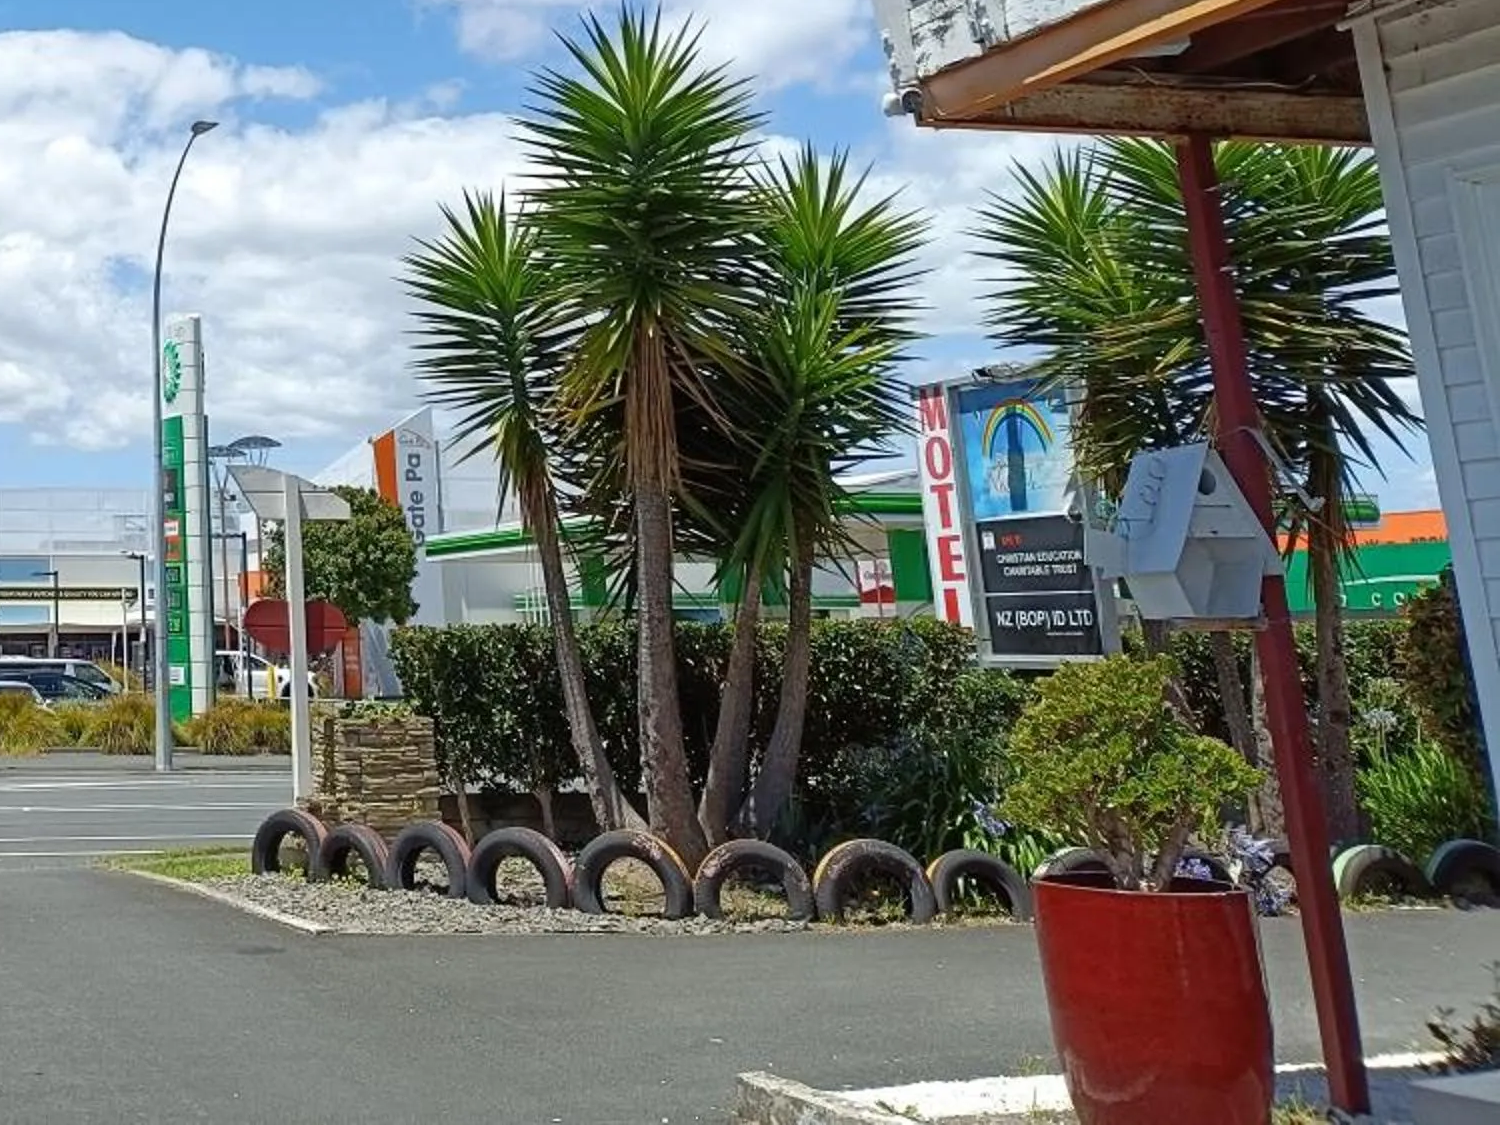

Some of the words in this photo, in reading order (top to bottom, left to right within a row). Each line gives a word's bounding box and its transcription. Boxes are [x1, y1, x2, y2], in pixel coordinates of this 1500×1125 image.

[405, 453, 422, 482] Pa
[1051, 564, 1077, 575] TRUST
[995, 610, 1013, 627] NZ
[1015, 610, 1051, 630] (BOP)
[1068, 609, 1093, 626] LTD
